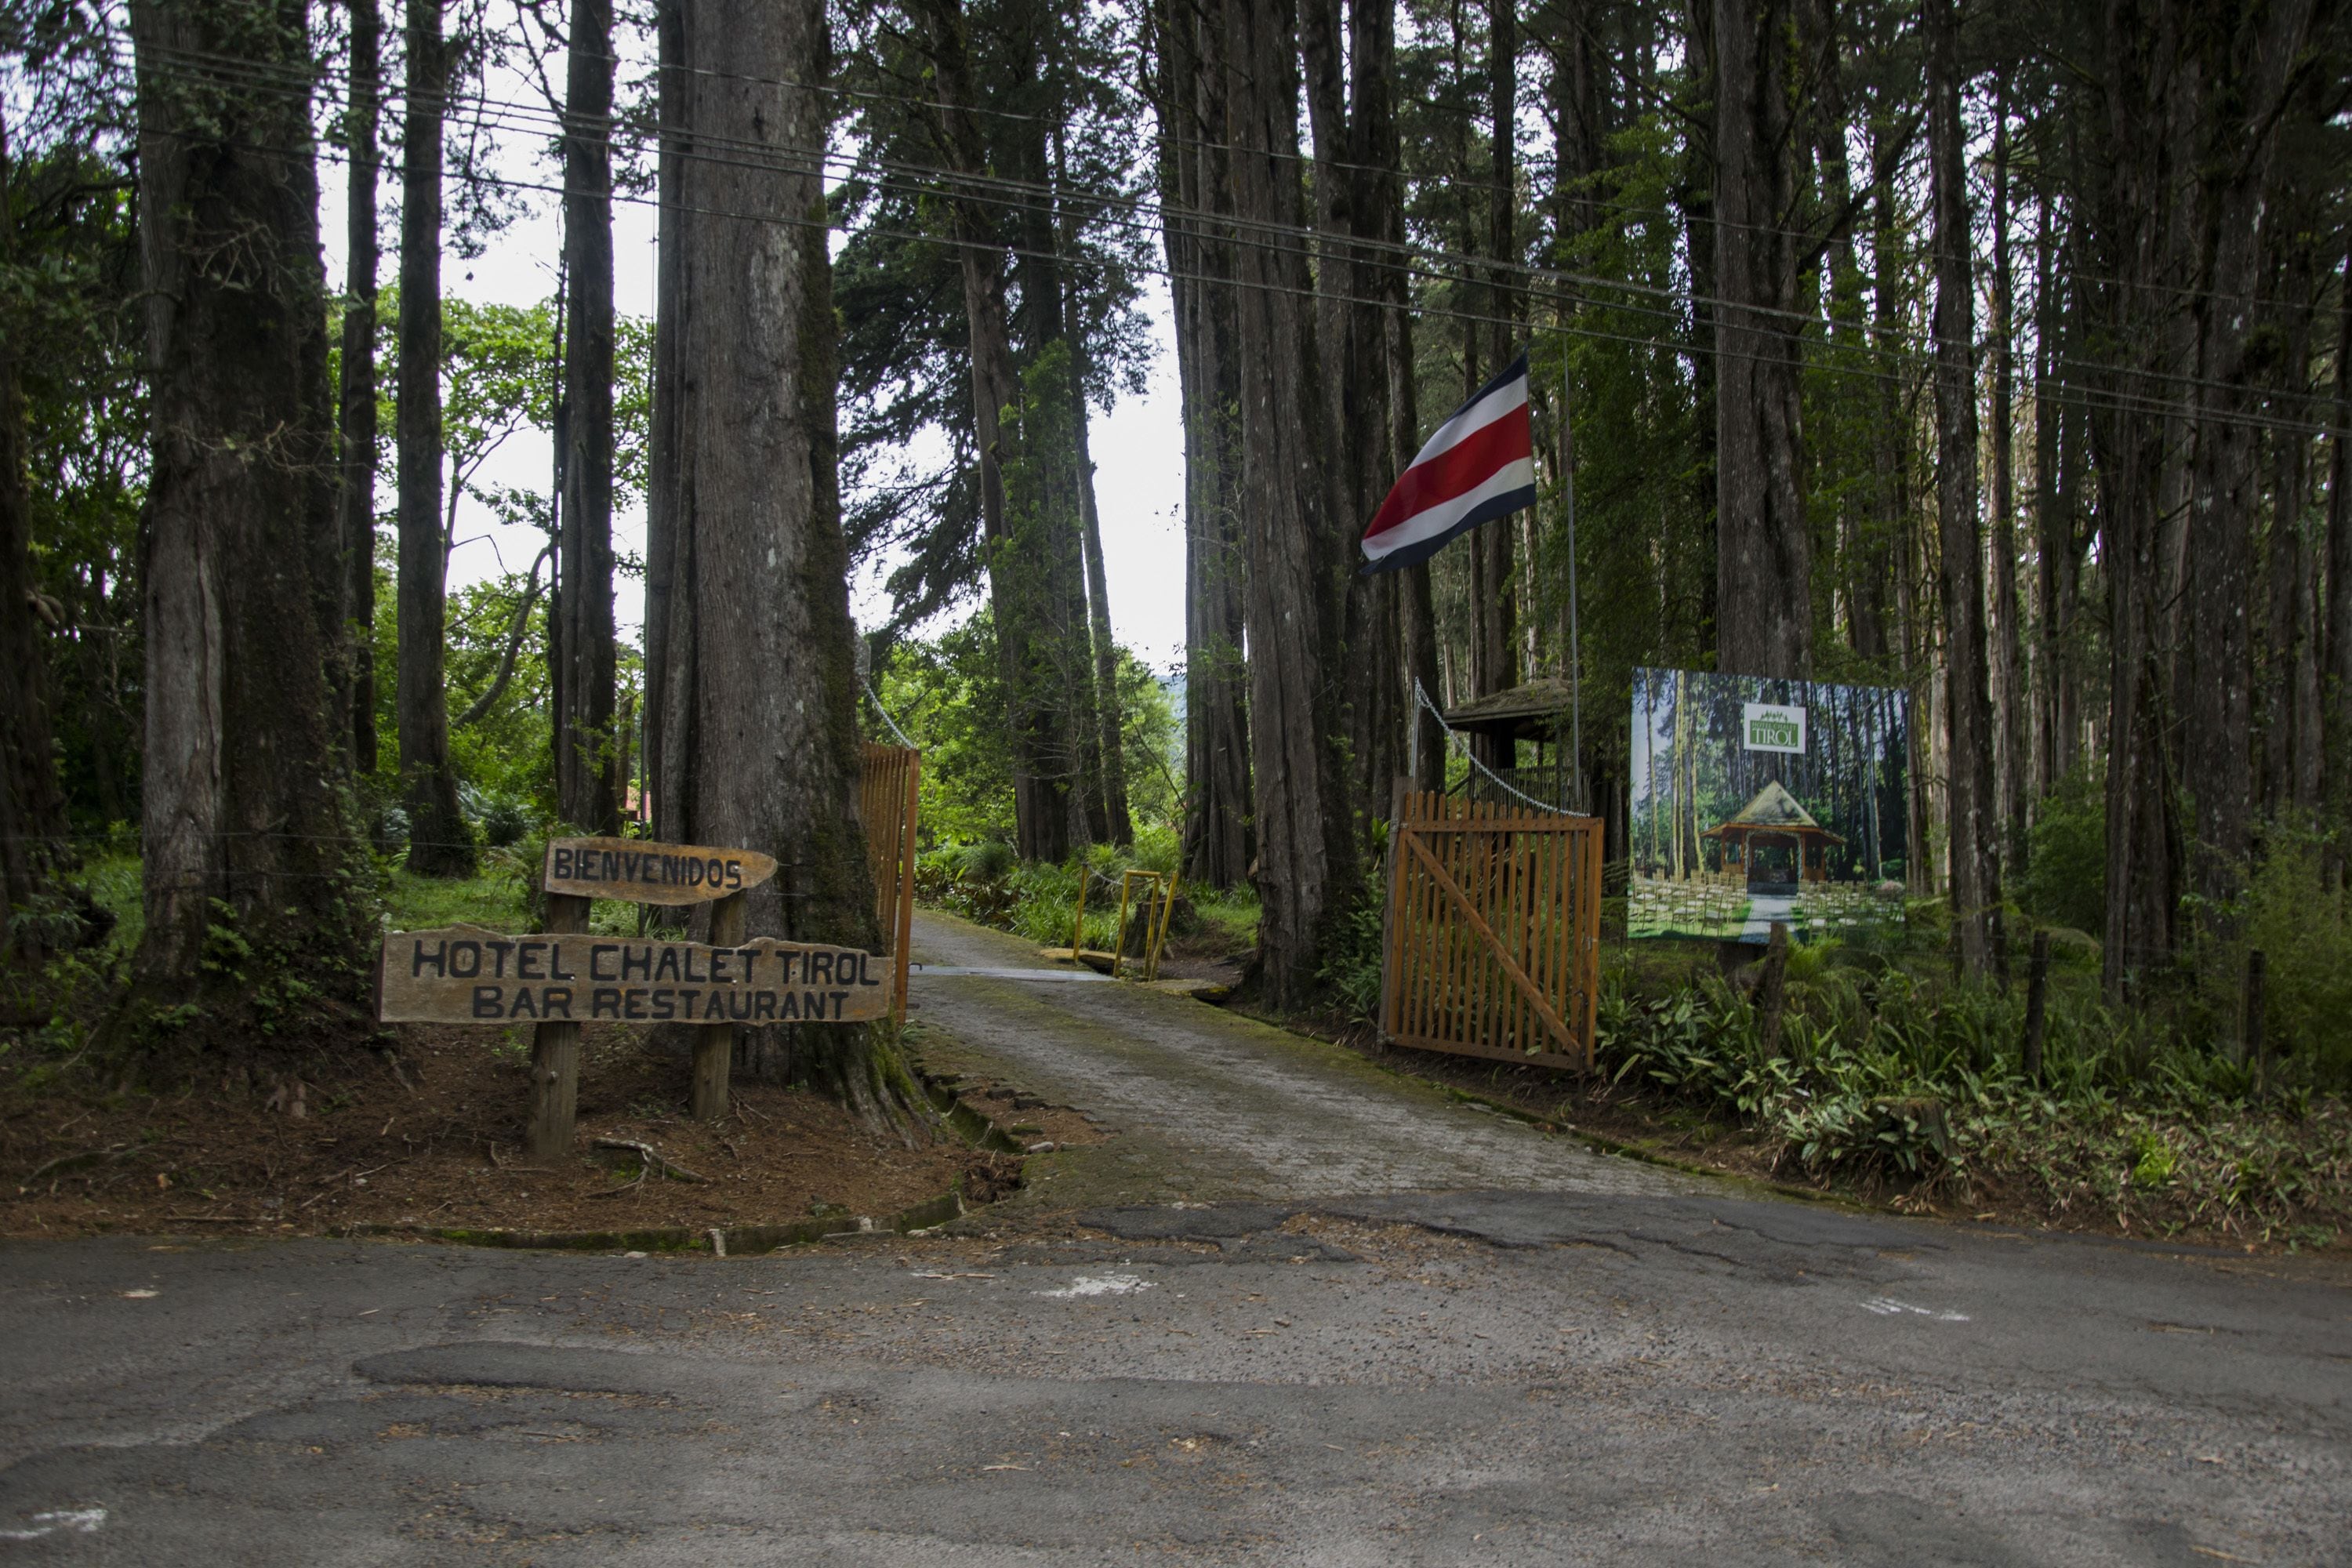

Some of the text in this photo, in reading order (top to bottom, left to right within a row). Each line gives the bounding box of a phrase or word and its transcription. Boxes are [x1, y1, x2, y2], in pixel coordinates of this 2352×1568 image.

[1752, 728, 1796, 746] TIROL
[554, 848, 742, 889] BIENVENIDOS
[412, 940, 880, 985] HOTEL CHALET TIROL
[473, 985, 850, 1020] BAR RESTAURANT
